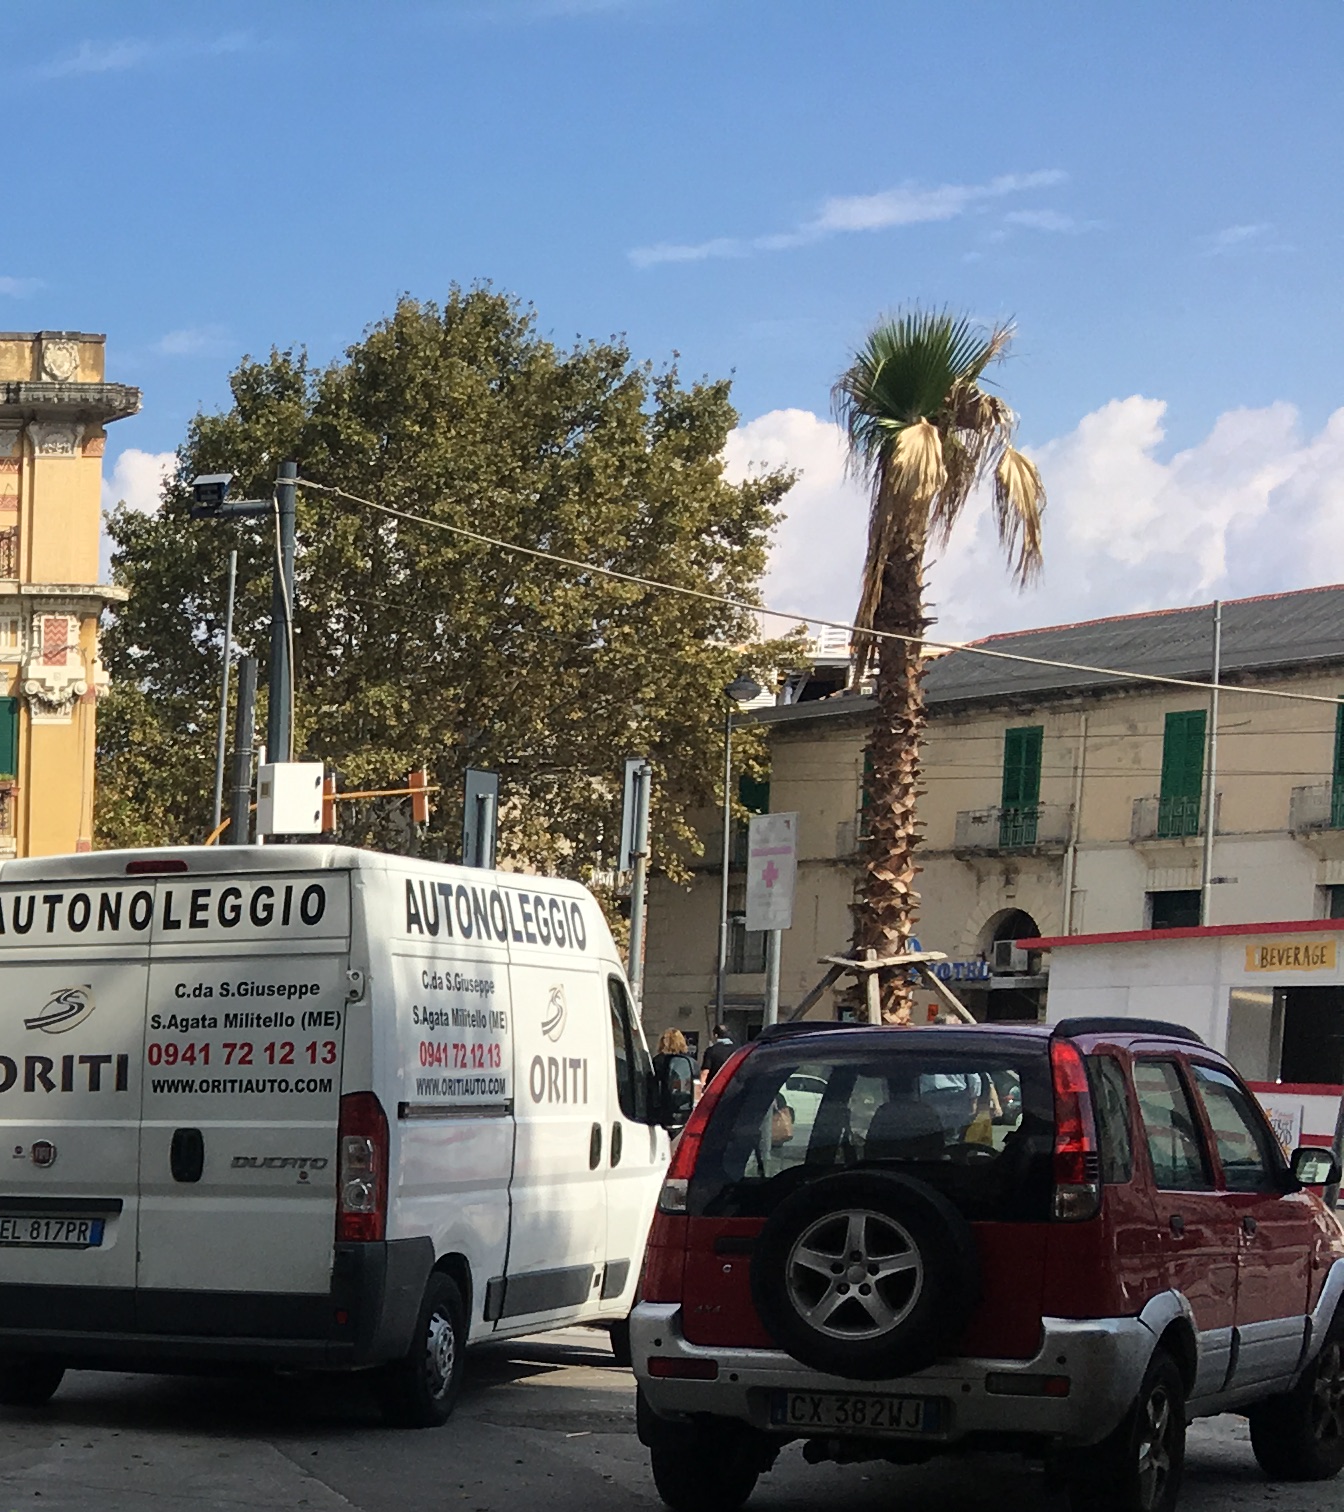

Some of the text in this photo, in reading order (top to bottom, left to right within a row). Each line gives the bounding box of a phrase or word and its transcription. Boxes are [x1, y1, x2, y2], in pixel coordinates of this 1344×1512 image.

[405, 878, 587, 951] AUTONOLEGGIO
[1260, 945, 1328, 968] BEVERAGE
[175, 981, 320, 1000] C.da S.Giuseppe
[422, 970, 495, 998] C.da S.Giuseppe
[150, 1010, 342, 1033] S.Agata Militello (ME)
[413, 1005, 508, 1034] S.Agata Militello (ME)
[147, 1040, 337, 1066] 0941 72 12 13
[420, 1041, 501, 1068] 0941 72 12 13
[151, 1078, 332, 1094] WWW.ORITIAUTO.COM
[416, 1078, 506, 1096] WWW.ORITIAUTO.COM
[529, 1054, 588, 1104] ORITI
[231, 1156, 328, 1169] DUCATO
[0, 1220, 89, 1241] EL 817PR
[791, 1395, 921, 1428] CX 382WJ
